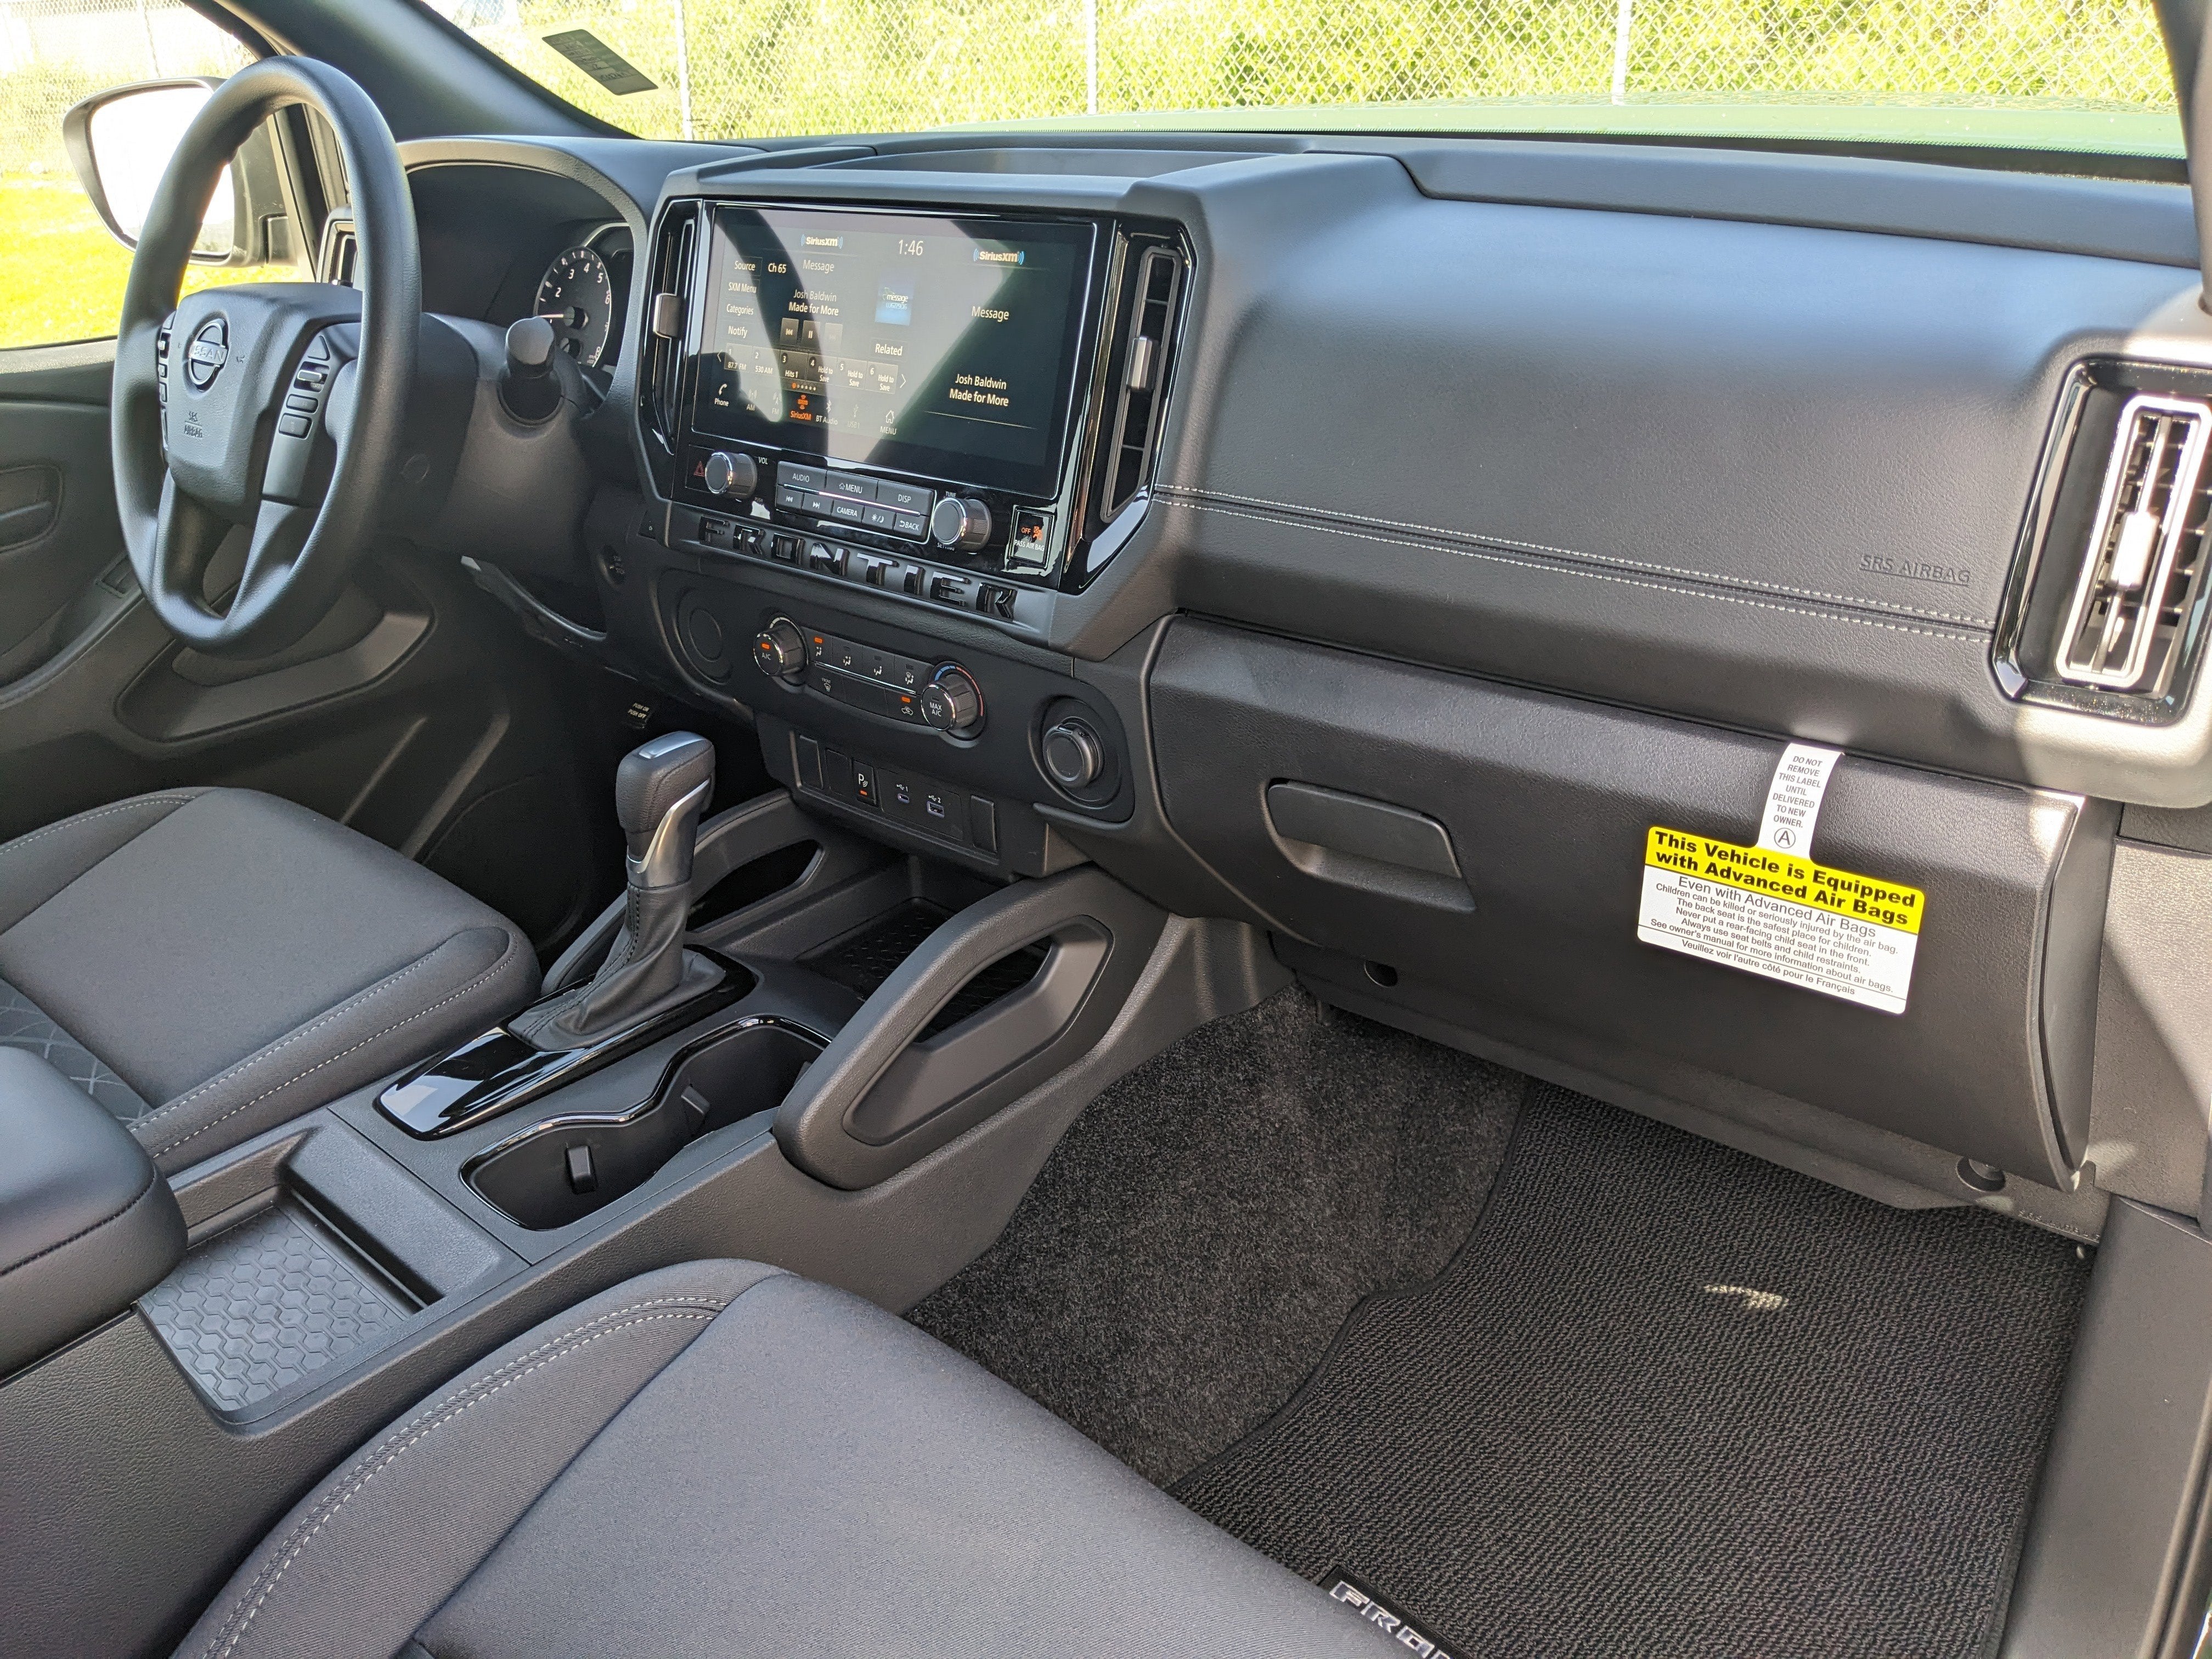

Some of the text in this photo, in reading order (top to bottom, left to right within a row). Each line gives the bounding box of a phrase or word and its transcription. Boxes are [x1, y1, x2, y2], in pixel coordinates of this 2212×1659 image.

[899, 239, 924, 256] 1:46
[583, 262, 590, 273] 4
[734, 261, 755, 272] Source
[768, 263, 787, 273] Ch 65
[803, 259, 834, 274] Message
[568, 269, 574, 279] 3
[597, 273, 603, 284] 5
[555, 287, 562, 297] 2
[729, 282, 757, 294] SXM Menu
[793, 289, 837, 302] Josh Baldwin
[726, 304, 754, 315] Categories
[788, 302, 839, 316] Made for More
[972, 306, 1009, 322] Message
[728, 326, 747, 338] Notify
[875, 343, 902, 356] Related
[849, 379, 860, 387] Save
[878, 374, 889, 382] Hold
[955, 374, 1007, 390] Josh Baldwin
[879, 383, 890, 392] Save
[714, 398, 729, 407] Phone
[950, 388, 1009, 407] Made for More
[823, 416, 838, 426] Audio
[880, 426, 896, 435] MENU
[758, 456, 768, 465] VOL
[792, 473, 810, 483] AUDIO
[845, 483, 863, 494] MENU
[898, 494, 912, 503] DISP
[837, 506, 857, 517] CAMERA
[905, 522, 919, 531] BACK
[1014, 539, 1045, 551] PASS AIR BAG
[699, 516, 1018, 620] FRONTIER
[1860, 555, 1971, 584] SRS AIRBAG
[761, 652, 771, 661] A/C
[929, 702, 942, 711] MAX
[1792, 755, 1823, 767] DO NOT
[1787, 764, 1820, 777] REMOVE
[1779, 772, 1821, 788] THIS LABEL
[1786, 785, 1807, 796] UNTIL
[1773, 793, 1815, 809] DELIVERED
[1777, 804, 1806, 817] TO NEW
[1773, 815, 1803, 828] OWNER.
[1777, 830, 1792, 846] A
[1655, 831, 1916, 908] This Vehicle is Equipped
[1656, 851, 1908, 924] with Advanced Air Bags
[1678, 876, 1876, 937] Even with Advanced Air Bags
[1656, 883, 1690, 898] Children
[1692, 894, 1708, 902] can
[1710, 897, 1721, 906] be
[1723, 900, 1745, 913] killed
[1758, 911, 1798, 928] seriously
[1800, 921, 1830, 935] injured
[1833, 929, 1844, 940] by
[1847, 934, 1861, 943] the
[1864, 939, 1876, 947] air
[1878, 942, 1898, 955] bag.
[1677, 898, 1871, 957] The back seat is the safest place for children.
[1676, 906, 1701, 919] Never
[1703, 915, 1717, 924] put
[1726, 921, 1772, 941] rear-facing
[1775, 934, 1795, 946] child
[1797, 941, 1816, 951] seat
[1819, 946, 1827, 954] in
[1830, 949, 1844, 959] the
[1847, 953, 1870, 966] front.
[1681, 918, 1861, 974] Always use seat belts and child restraints.
[1651, 918, 1893, 992] See owner's manual for more information about air bags.
[1682, 939, 1855, 995] Veuillez voir l'autre côté pour le Français
